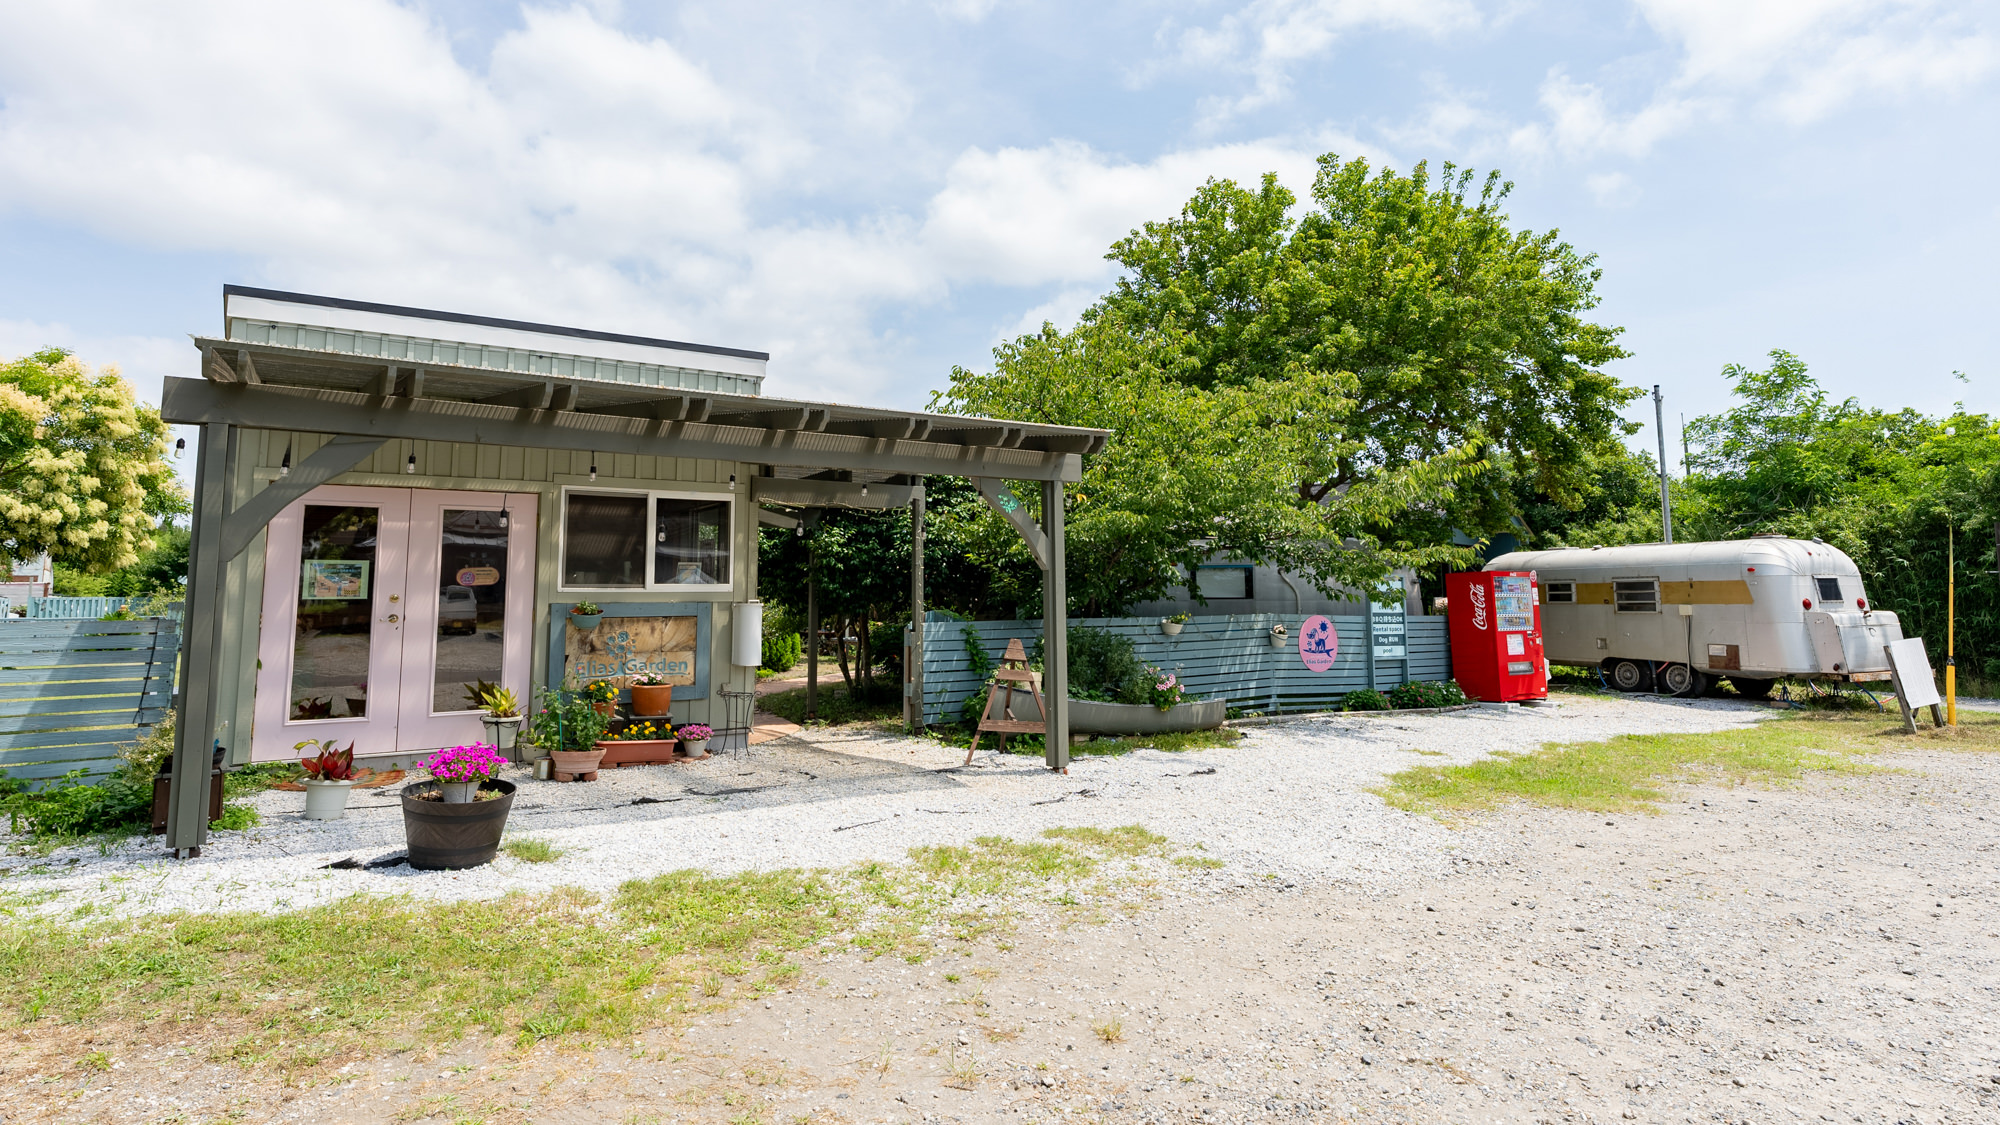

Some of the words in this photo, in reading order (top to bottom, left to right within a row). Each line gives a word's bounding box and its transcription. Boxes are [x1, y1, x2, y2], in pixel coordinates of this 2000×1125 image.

[1379, 636, 1388, 644] Dog
[575, 660, 615, 676] Elias
[624, 658, 688, 673] Garden
